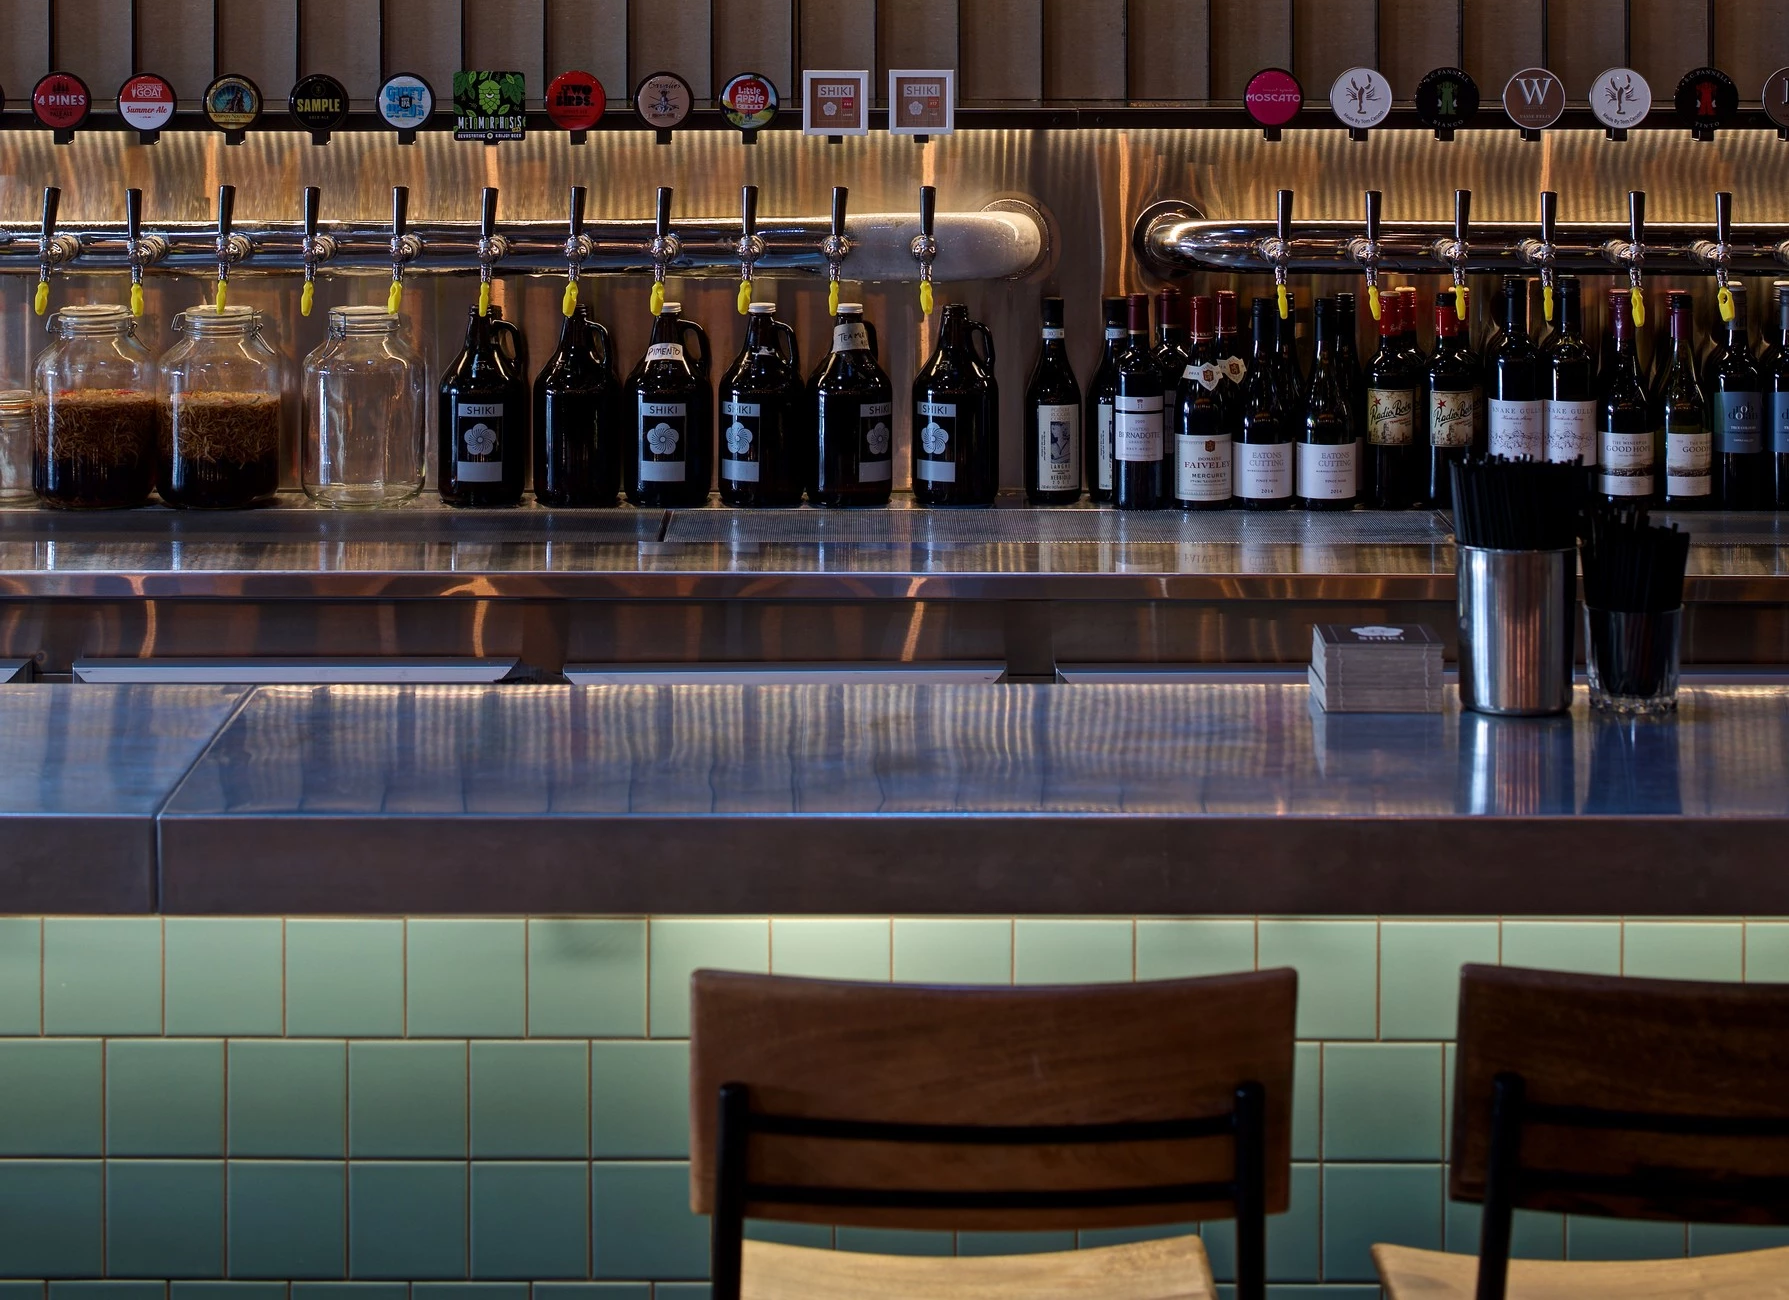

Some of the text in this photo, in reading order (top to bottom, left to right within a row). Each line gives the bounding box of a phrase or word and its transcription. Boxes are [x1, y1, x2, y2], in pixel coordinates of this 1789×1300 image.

[137, 88, 162, 97] GOAT
[561, 84, 593, 95] TWO
[737, 86, 761, 95] Little
[820, 87, 852, 96] SHIKI
[906, 86, 938, 95] SHIKI
[37, 94, 86, 106] 4 PINES
[1245, 93, 1301, 102] MOSCATO
[126, 105, 168, 114] Summer Ale
[296, 98, 341, 113] SAMPLE
[1343, 112, 1354, 122] Made
[1602, 112, 1613, 122] Made
[1432, 119, 1464, 128] BIANCO
[1694, 120, 1720, 129] TINTO
[838, 332, 853, 342] TEA
[648, 346, 681, 356] PIMENTO
[467, 406, 495, 415] SHIKI
[649, 405, 678, 414] SHIKI
[922, 404, 947, 415] SHIKI
[1370, 404, 1396, 426] Radio
[1433, 406, 1461, 428] Radio
[1118, 431, 1161, 439] BERNADOTTE
[1606, 445, 1632, 453] GOOD
[1252, 451, 1282, 459] EATONS
[1184, 460, 1231, 469] FAIVELEY
[1249, 459, 1285, 467] CUTTING
